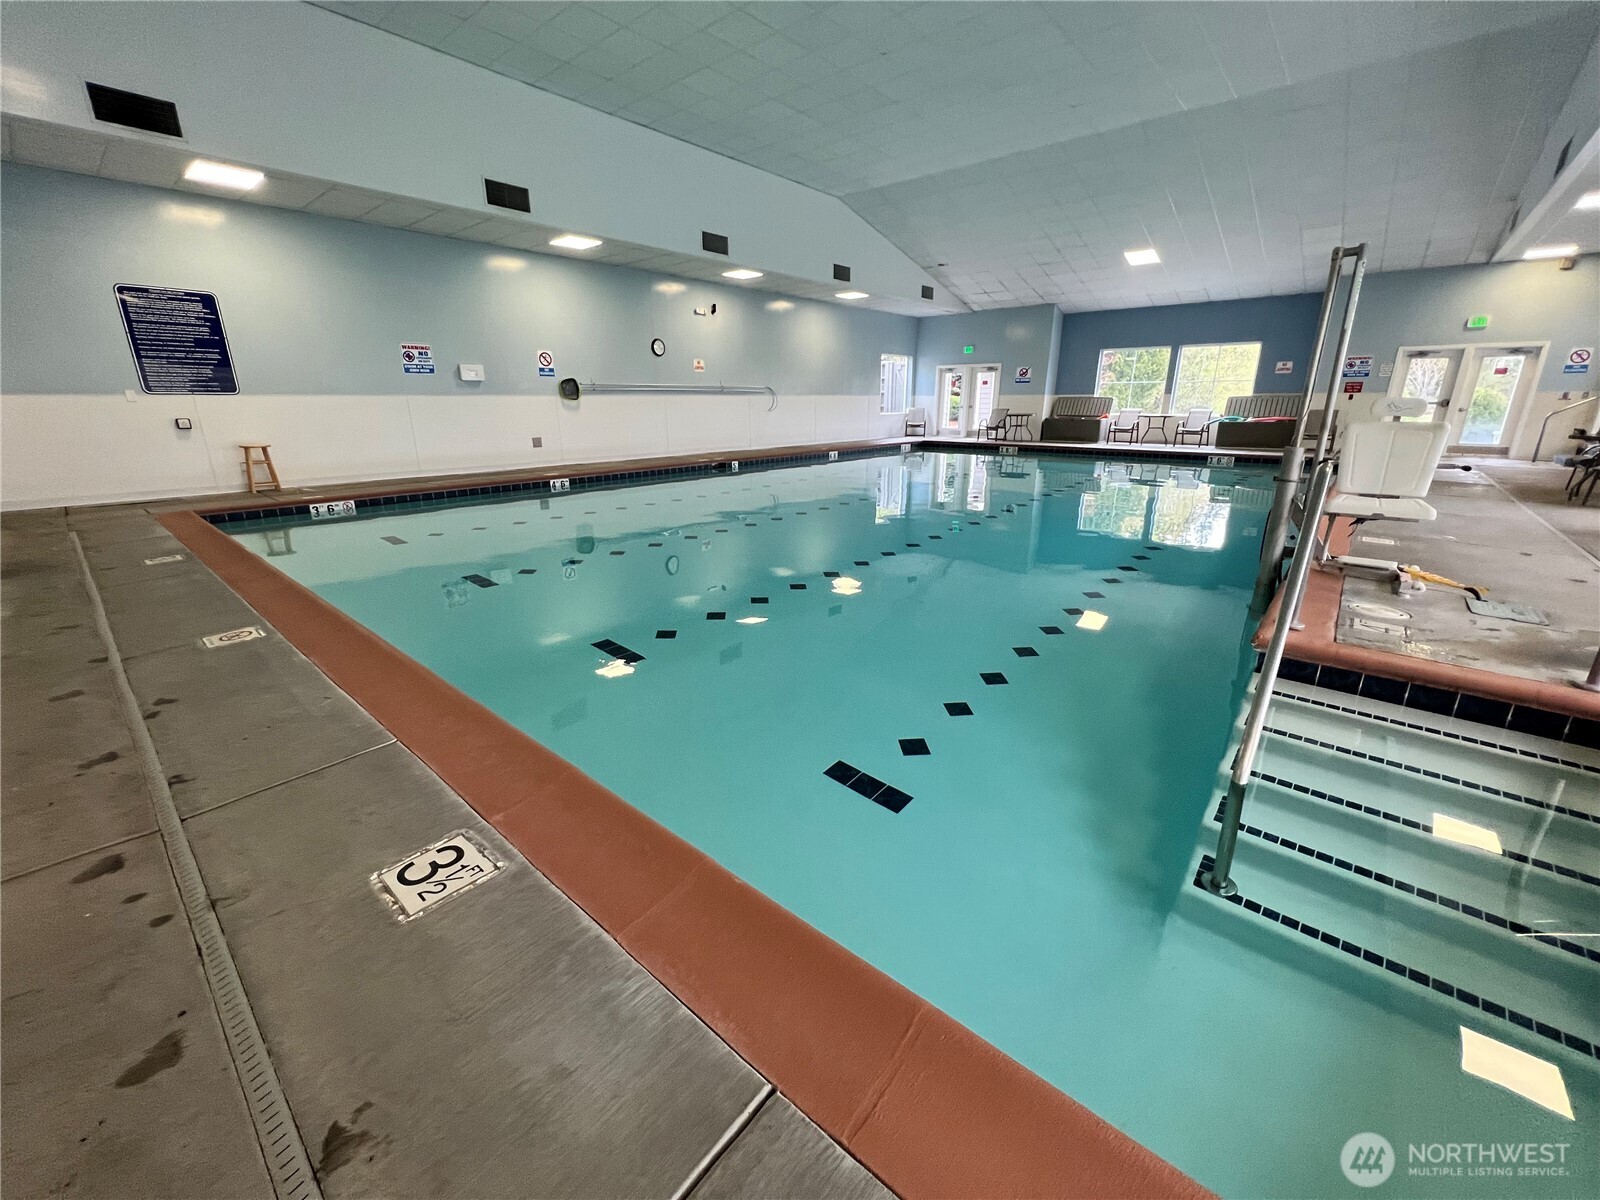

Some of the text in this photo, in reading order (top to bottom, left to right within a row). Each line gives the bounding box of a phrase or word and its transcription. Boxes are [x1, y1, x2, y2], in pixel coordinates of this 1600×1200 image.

[312, 506, 320, 518] 3
[327, 504, 335, 516] 6
[396, 845, 465, 886] 3
